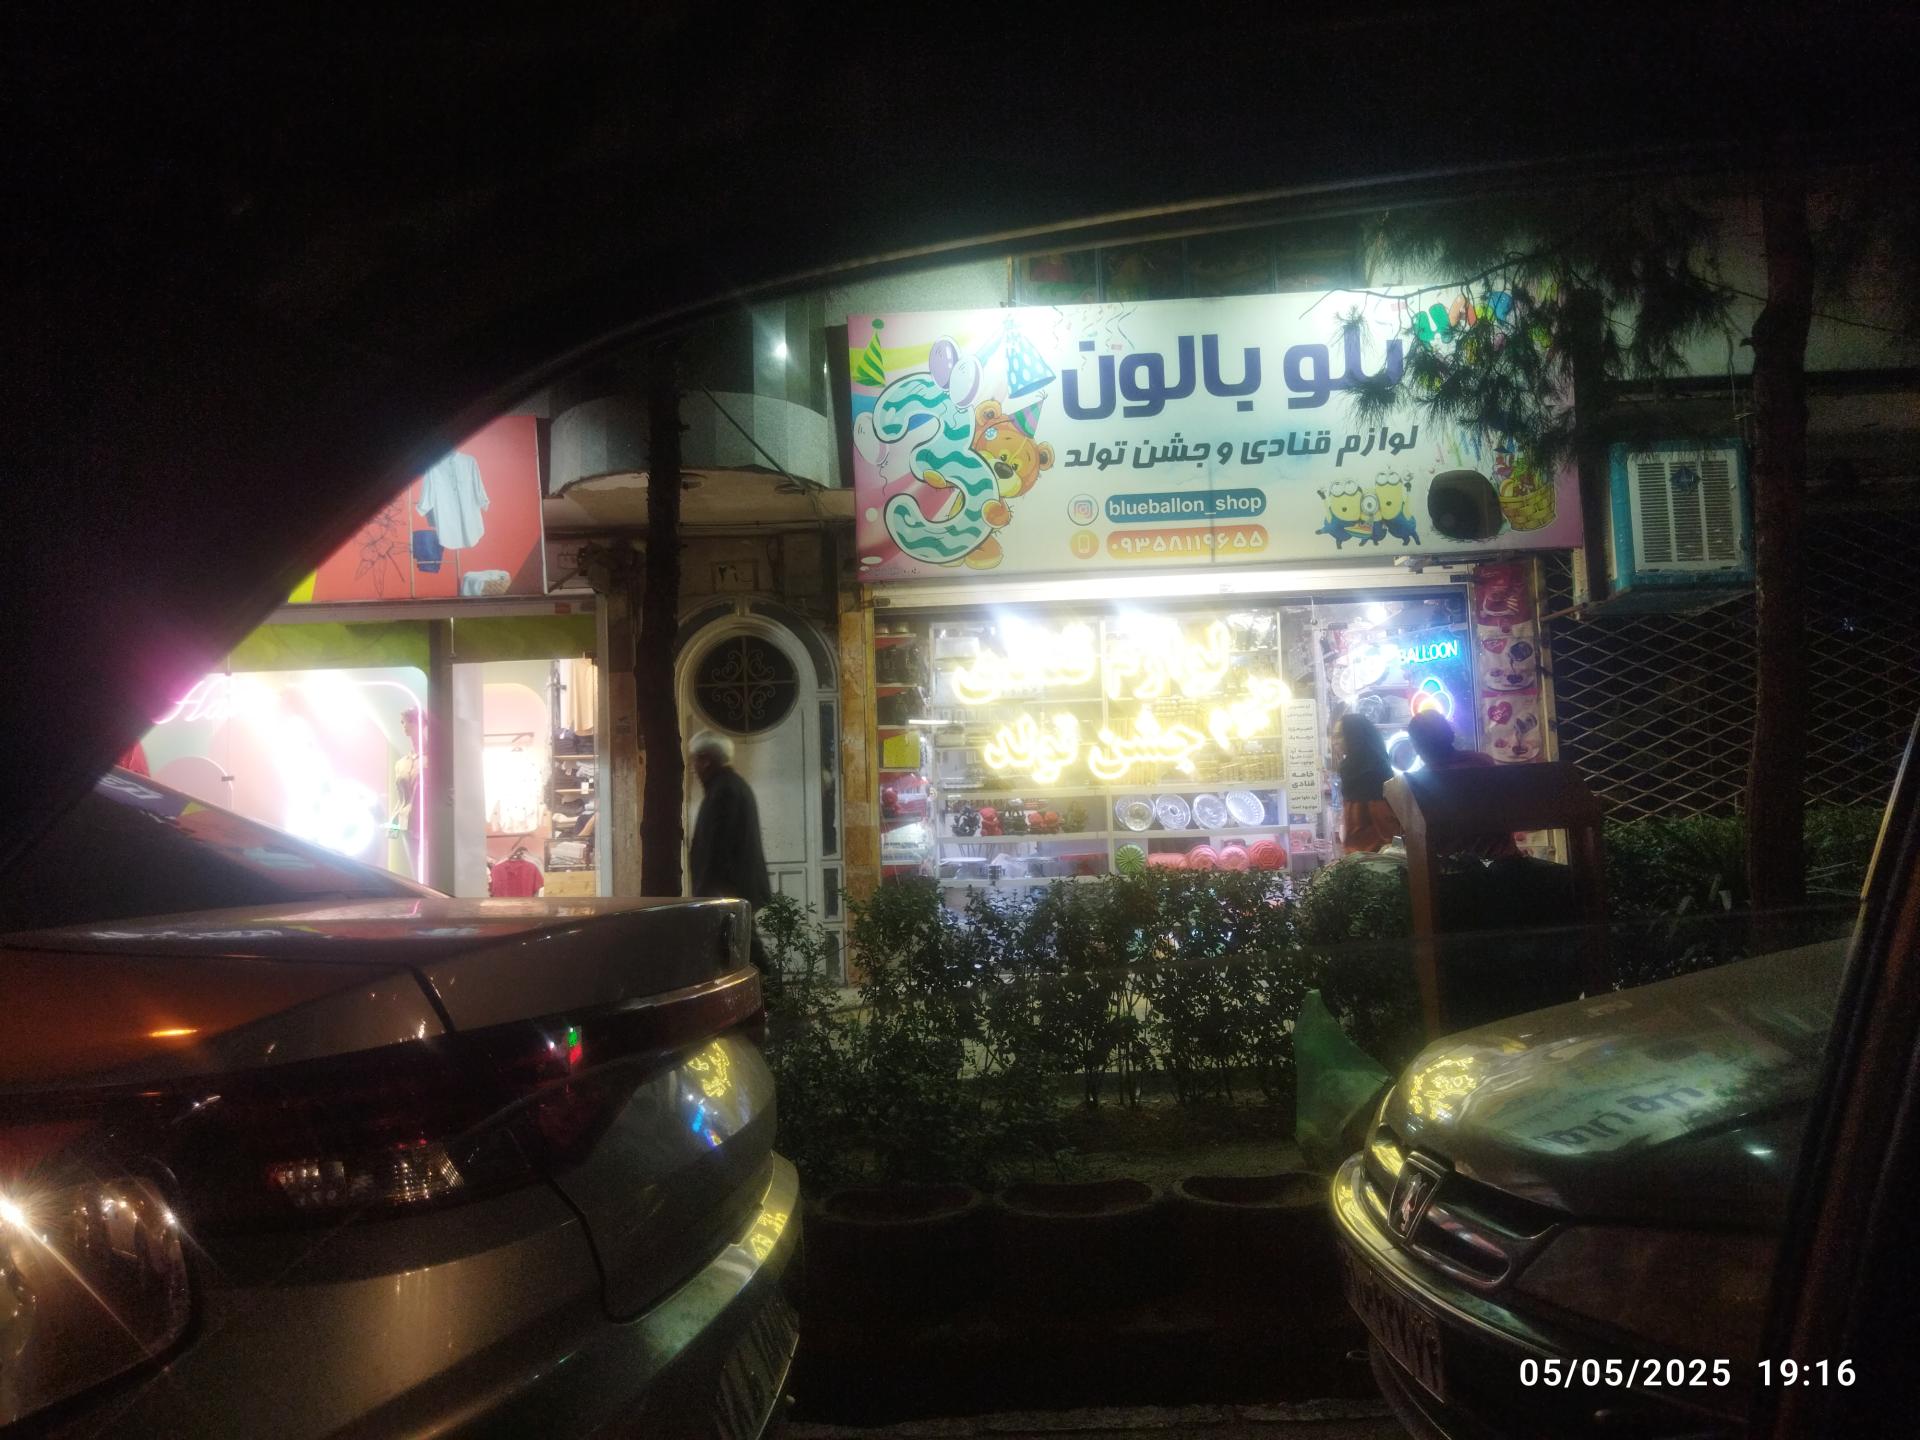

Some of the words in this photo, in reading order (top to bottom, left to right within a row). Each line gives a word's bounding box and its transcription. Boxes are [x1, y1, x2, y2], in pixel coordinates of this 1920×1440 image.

[1061, 334, 1262, 420] بالون
[1064, 440, 1128, 471] تولد
[1132, 432, 1211, 469] جشن
[1216, 441, 1233, 465] و
[1240, 430, 1331, 465] قنادی
[1335, 425, 1419, 467] لوازم
[1109, 495, 1262, 516] blueballon_shop
[1399, 640, 1458, 662] BALLOON
[1291, 780, 1316, 789] قنادی
